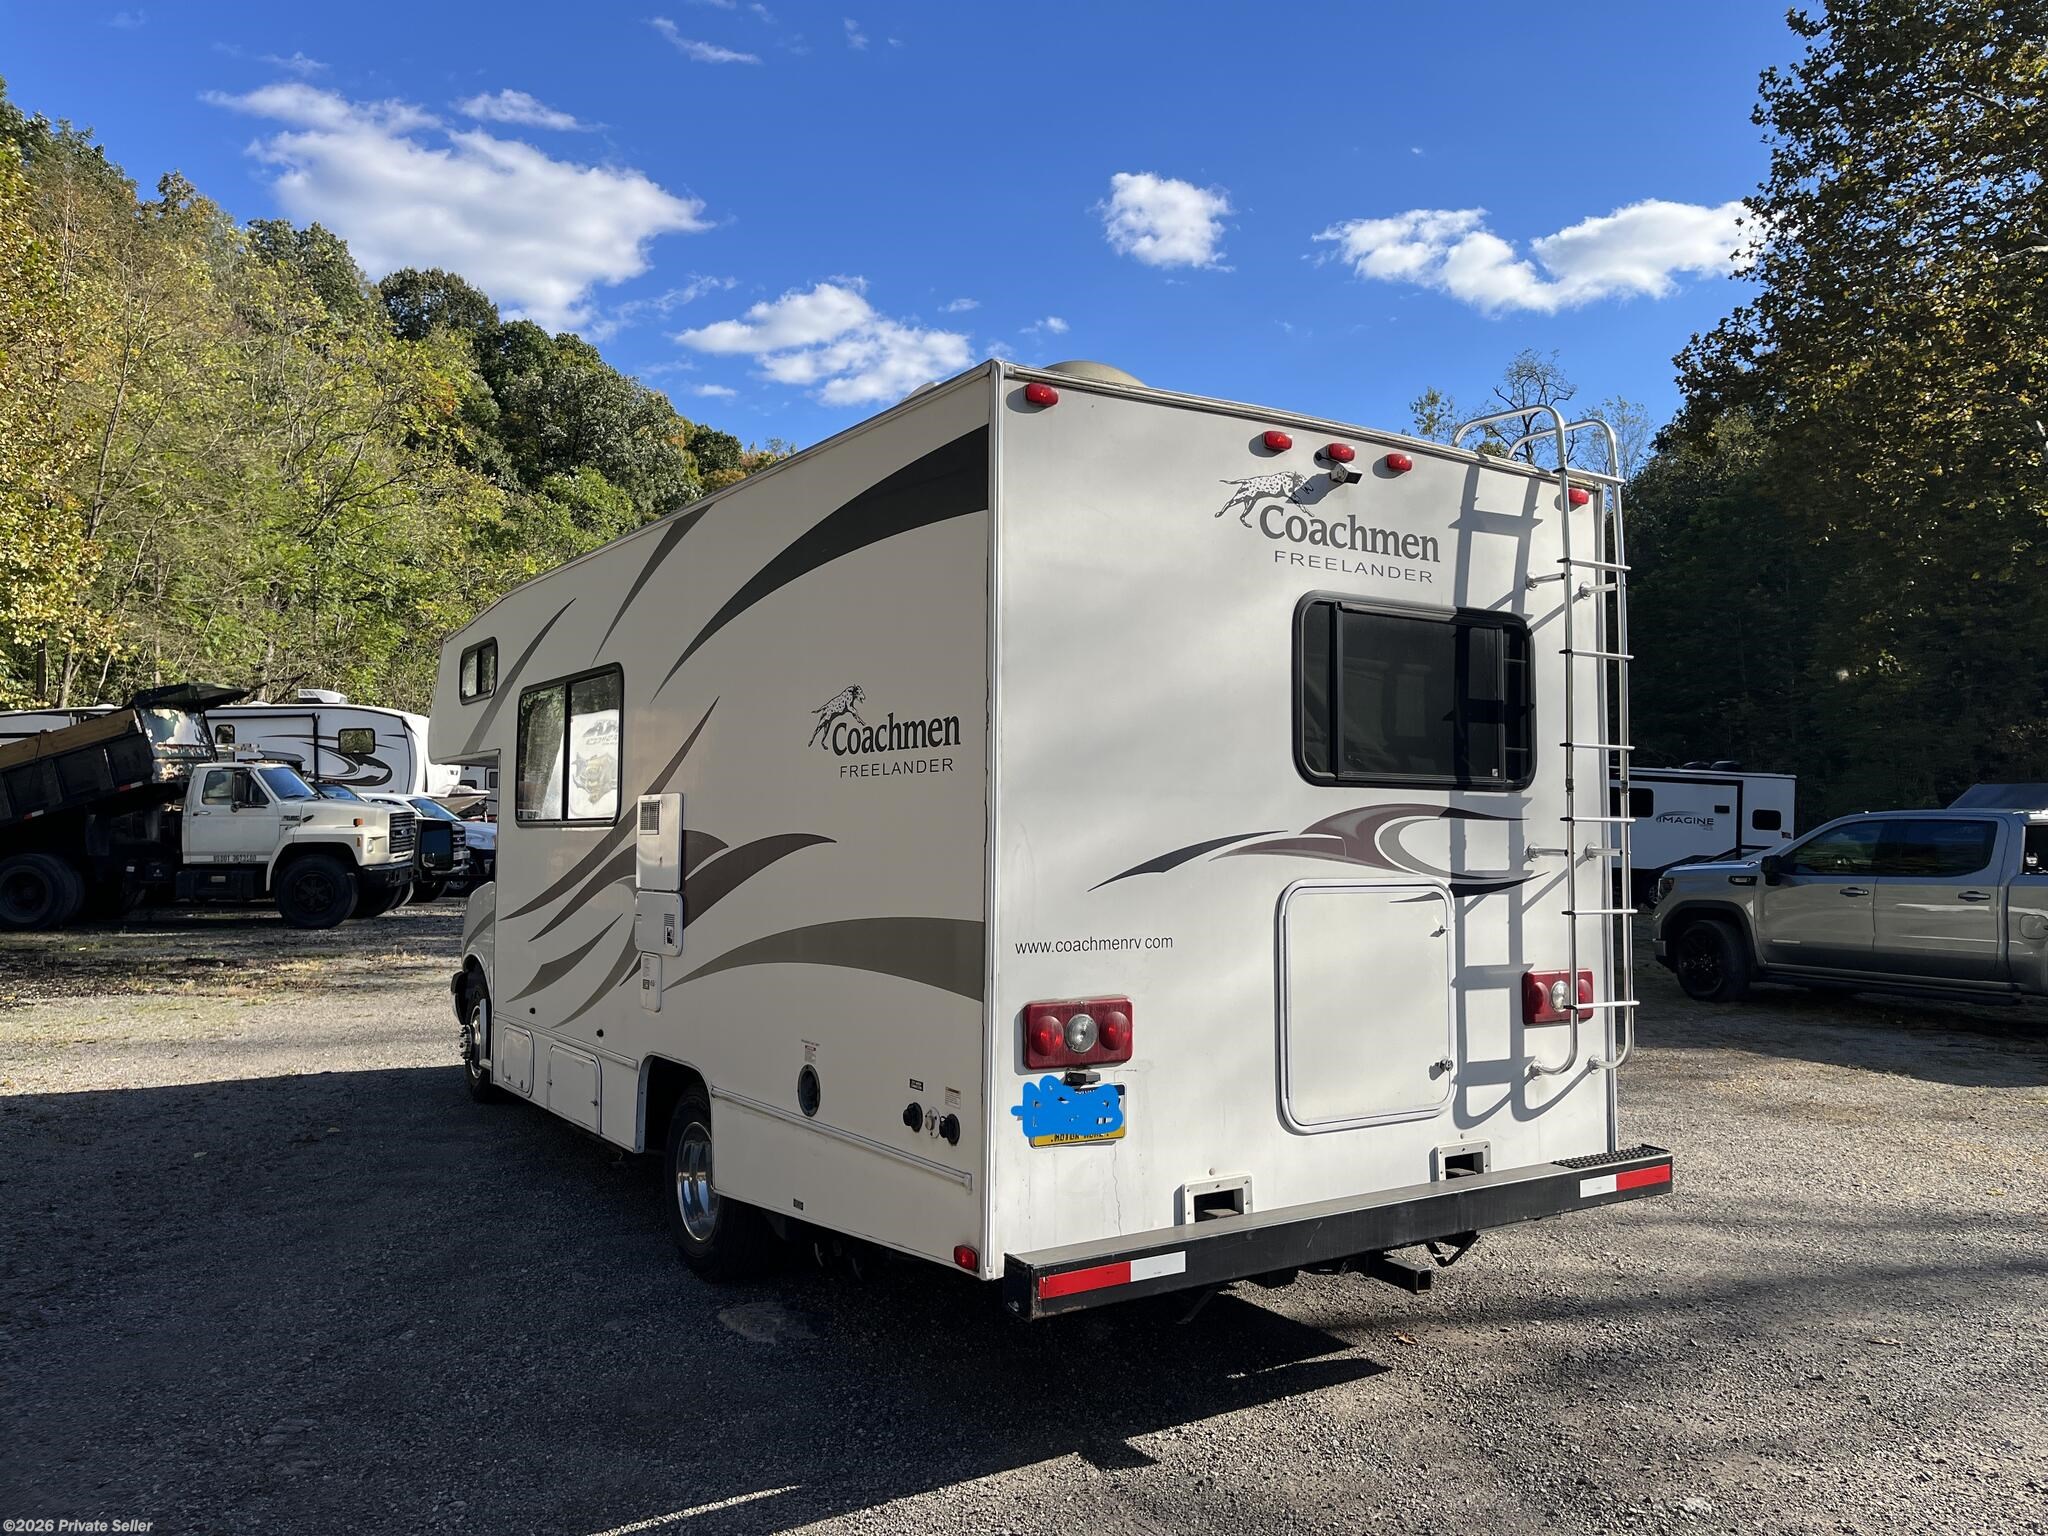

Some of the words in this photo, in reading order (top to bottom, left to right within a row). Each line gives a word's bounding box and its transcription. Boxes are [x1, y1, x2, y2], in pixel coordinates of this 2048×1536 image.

[1260, 504, 1440, 563] Coachmen
[1274, 550, 1433, 583] FREELANDER
[832, 712, 962, 757] Coachmen
[840, 758, 954, 779] FREELANDER
[1659, 816, 1714, 826] IMAGINE
